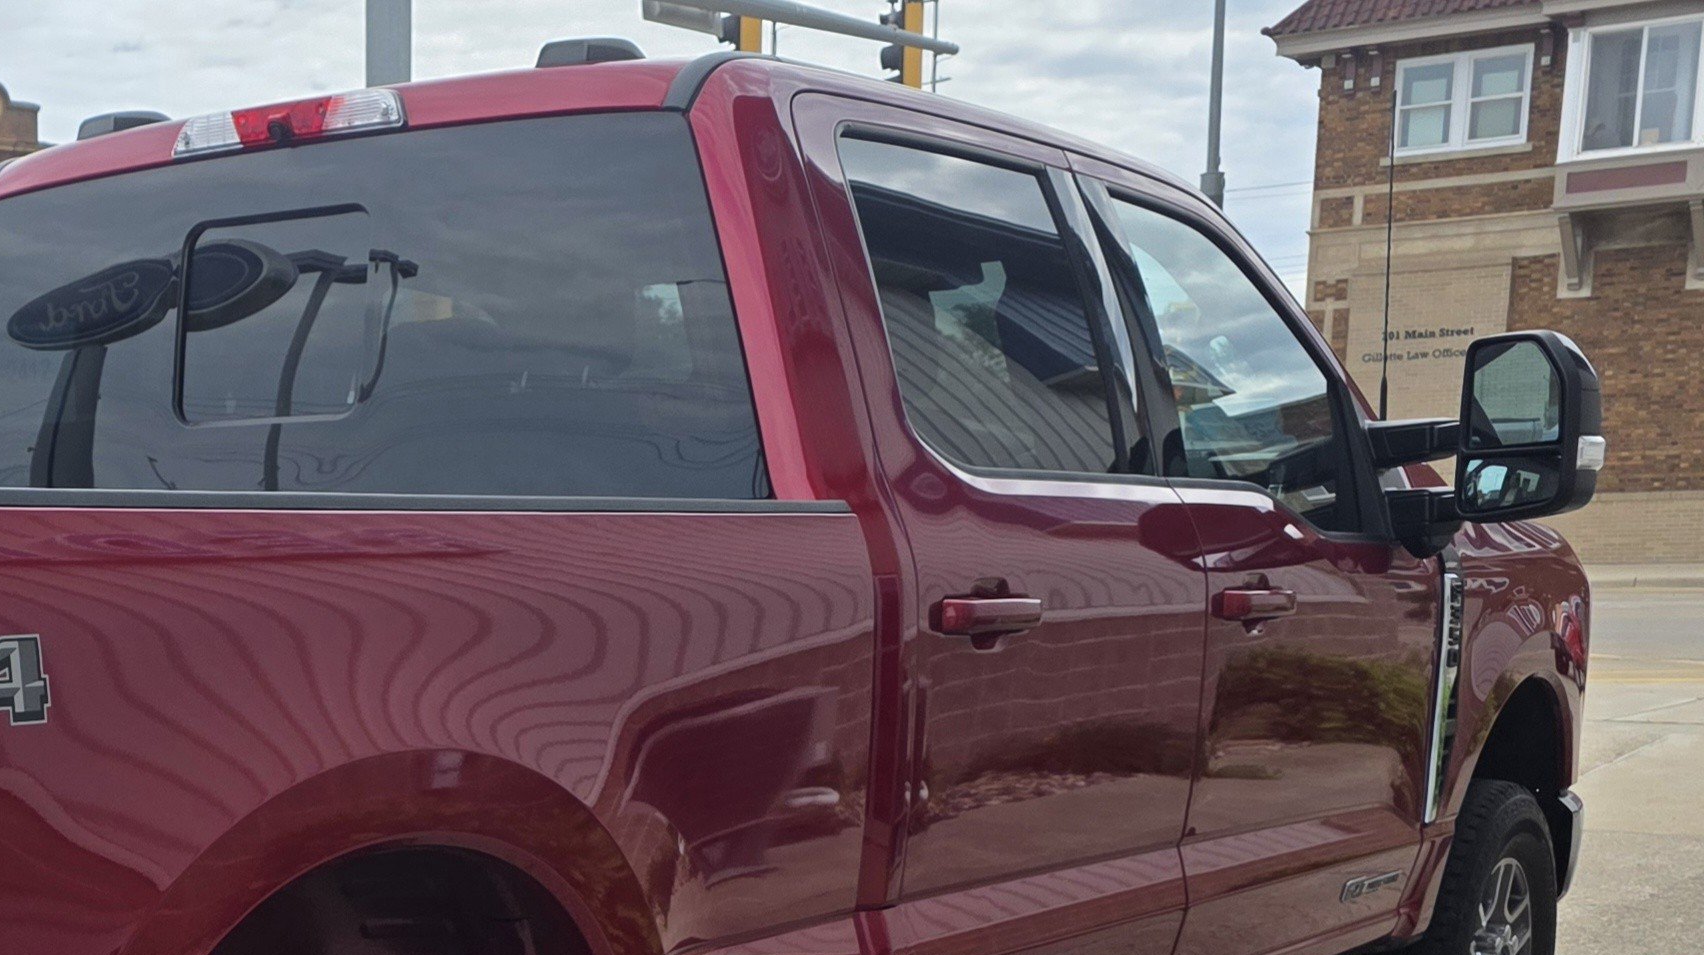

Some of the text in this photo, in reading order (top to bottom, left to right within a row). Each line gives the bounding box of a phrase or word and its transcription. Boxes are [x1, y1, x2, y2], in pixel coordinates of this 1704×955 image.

[1404, 329, 1436, 340] Main
[1439, 326, 1474, 338] Street
[1406, 350, 1429, 361] Law
